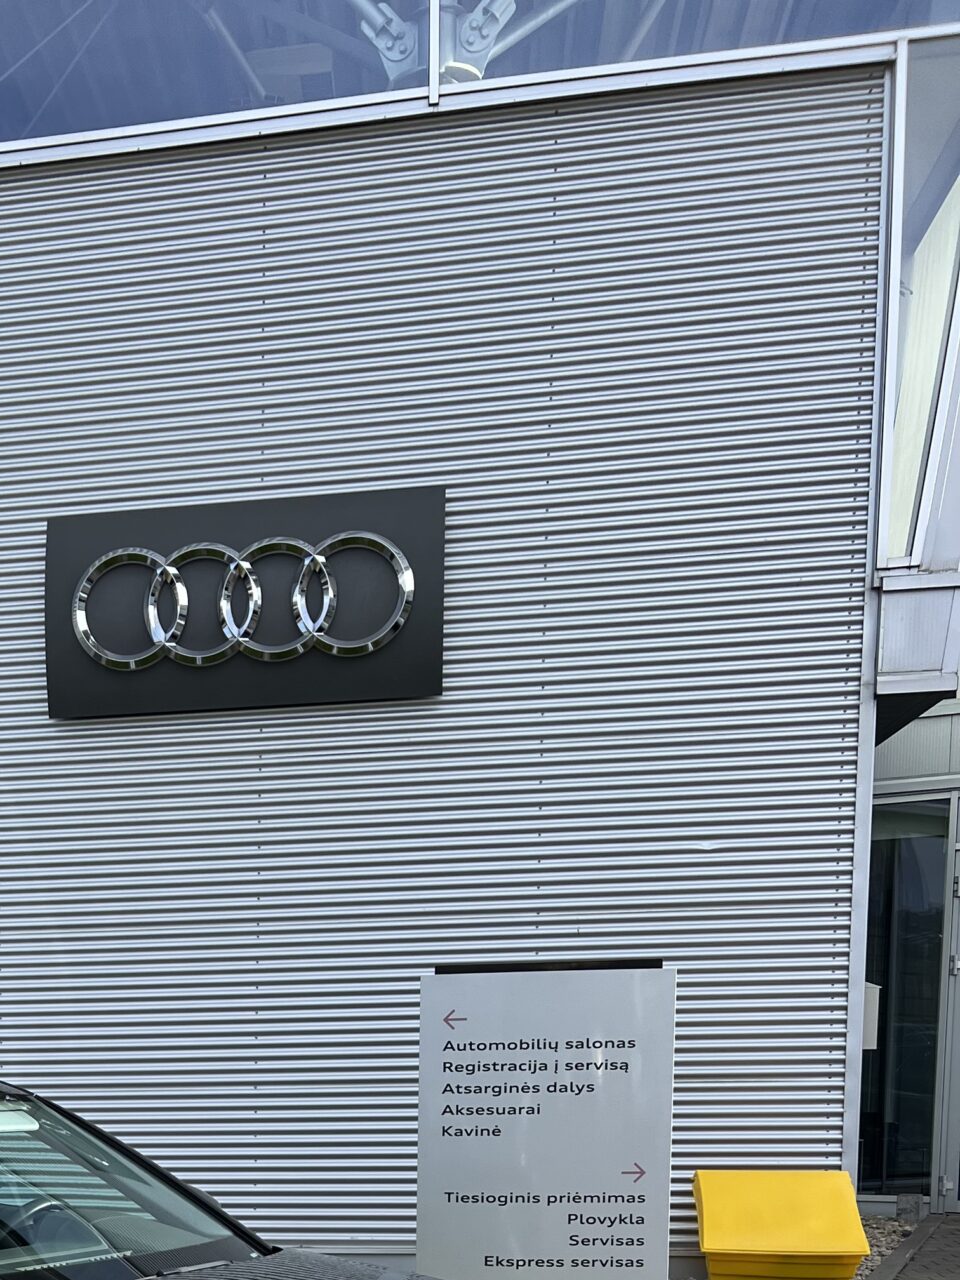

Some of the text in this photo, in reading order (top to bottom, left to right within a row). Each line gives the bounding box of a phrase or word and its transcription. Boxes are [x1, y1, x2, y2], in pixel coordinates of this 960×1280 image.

[442, 1037, 637, 1053] Automobilių salonas
[442, 1059, 548, 1075] Registracija
[564, 1058, 629, 1074] servisą
[441, 1080, 595, 1097] Atsarginės dalys
[441, 1103, 541, 1116] Aksesuarai
[441, 1124, 502, 1137] Kavinė
[444, 1191, 646, 1207] Tiesioginis priėmimas
[567, 1212, 645, 1228] Plovykla
[568, 1234, 645, 1248] Servisas
[484, 1255, 645, 1270] Ekspress servisas
